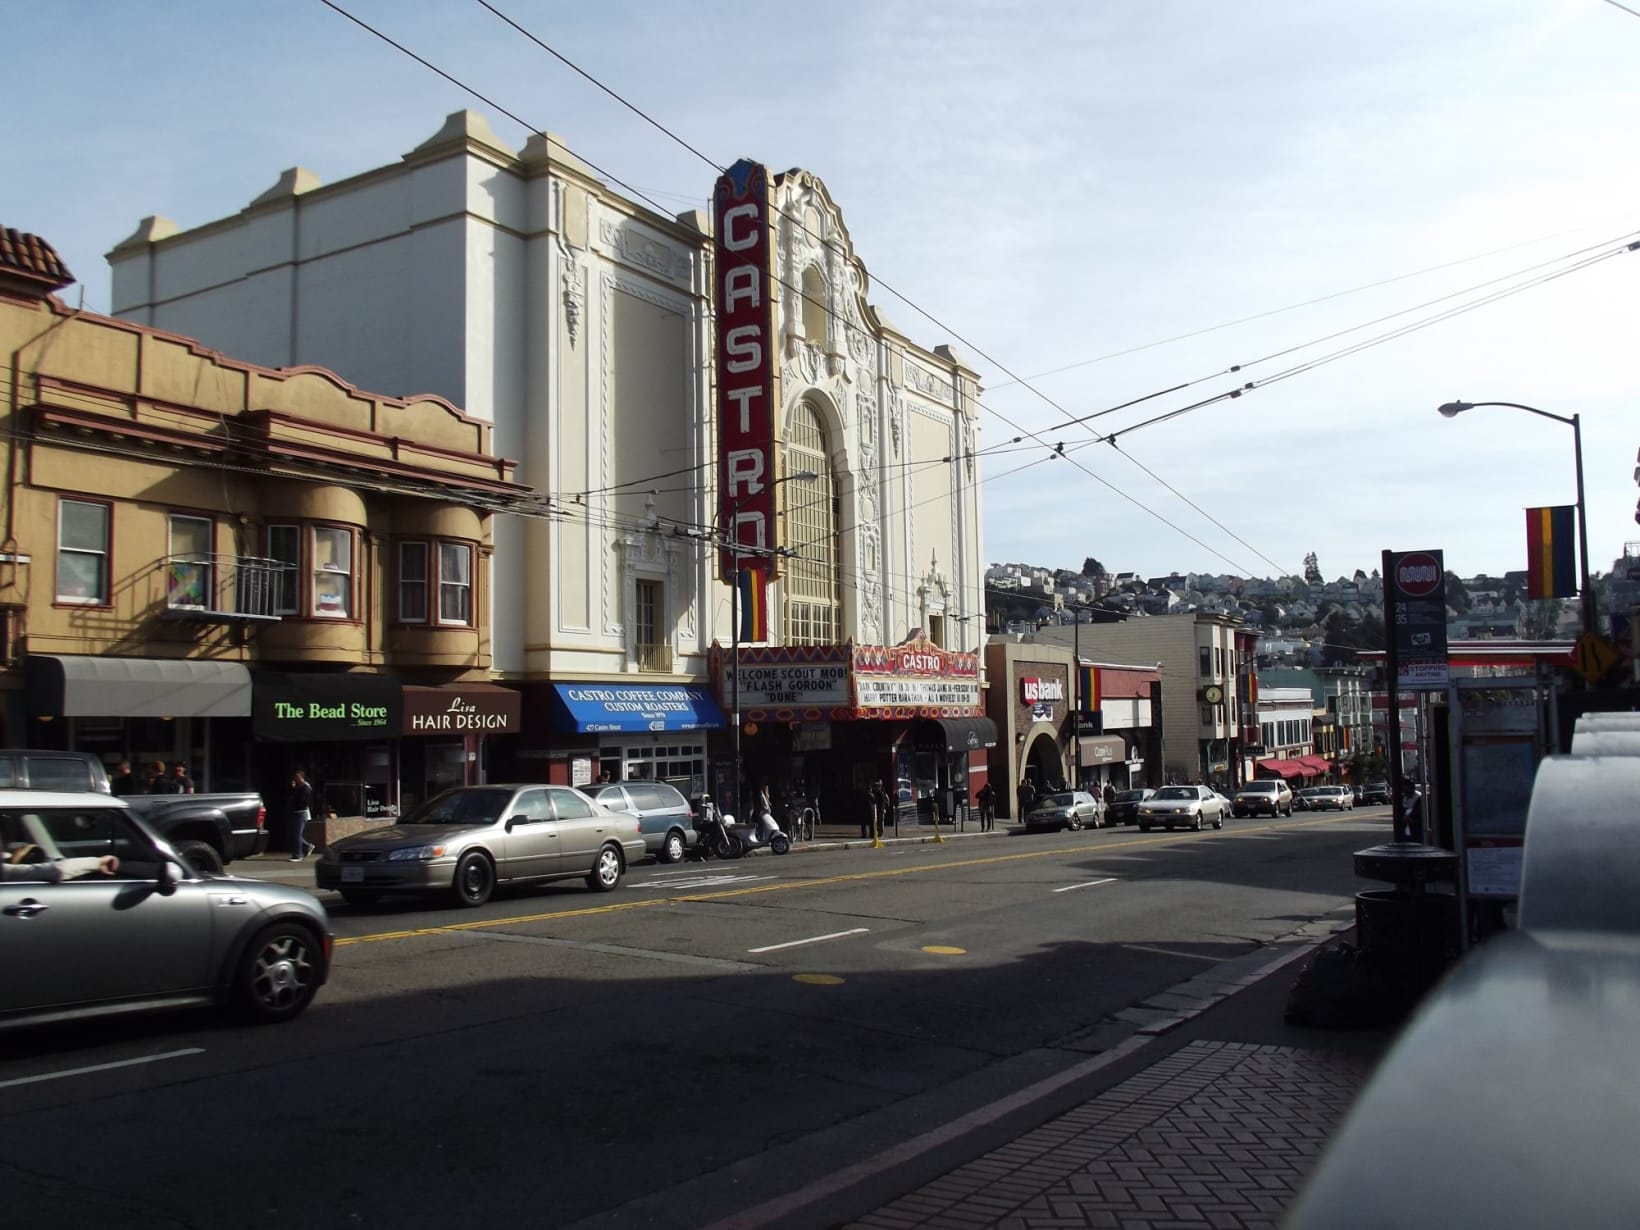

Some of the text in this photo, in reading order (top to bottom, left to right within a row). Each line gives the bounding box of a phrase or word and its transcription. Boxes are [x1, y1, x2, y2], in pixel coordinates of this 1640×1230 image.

[722, 202, 766, 559] CASTRO
[1396, 602, 1407, 613] 24
[1396, 614, 1408, 625] 35
[903, 654, 940, 670] CASTRO
[781, 669, 816, 680] SCOUT
[568, 689, 704, 702] CASTRO COFFEE COMPANY
[275, 702, 387, 719] The Bead Store
[447, 697, 476, 713] Lisa
[604, 702, 689, 712] CUSTOM ROASTERS
[412, 713, 508, 730] HAIR DESIGN
